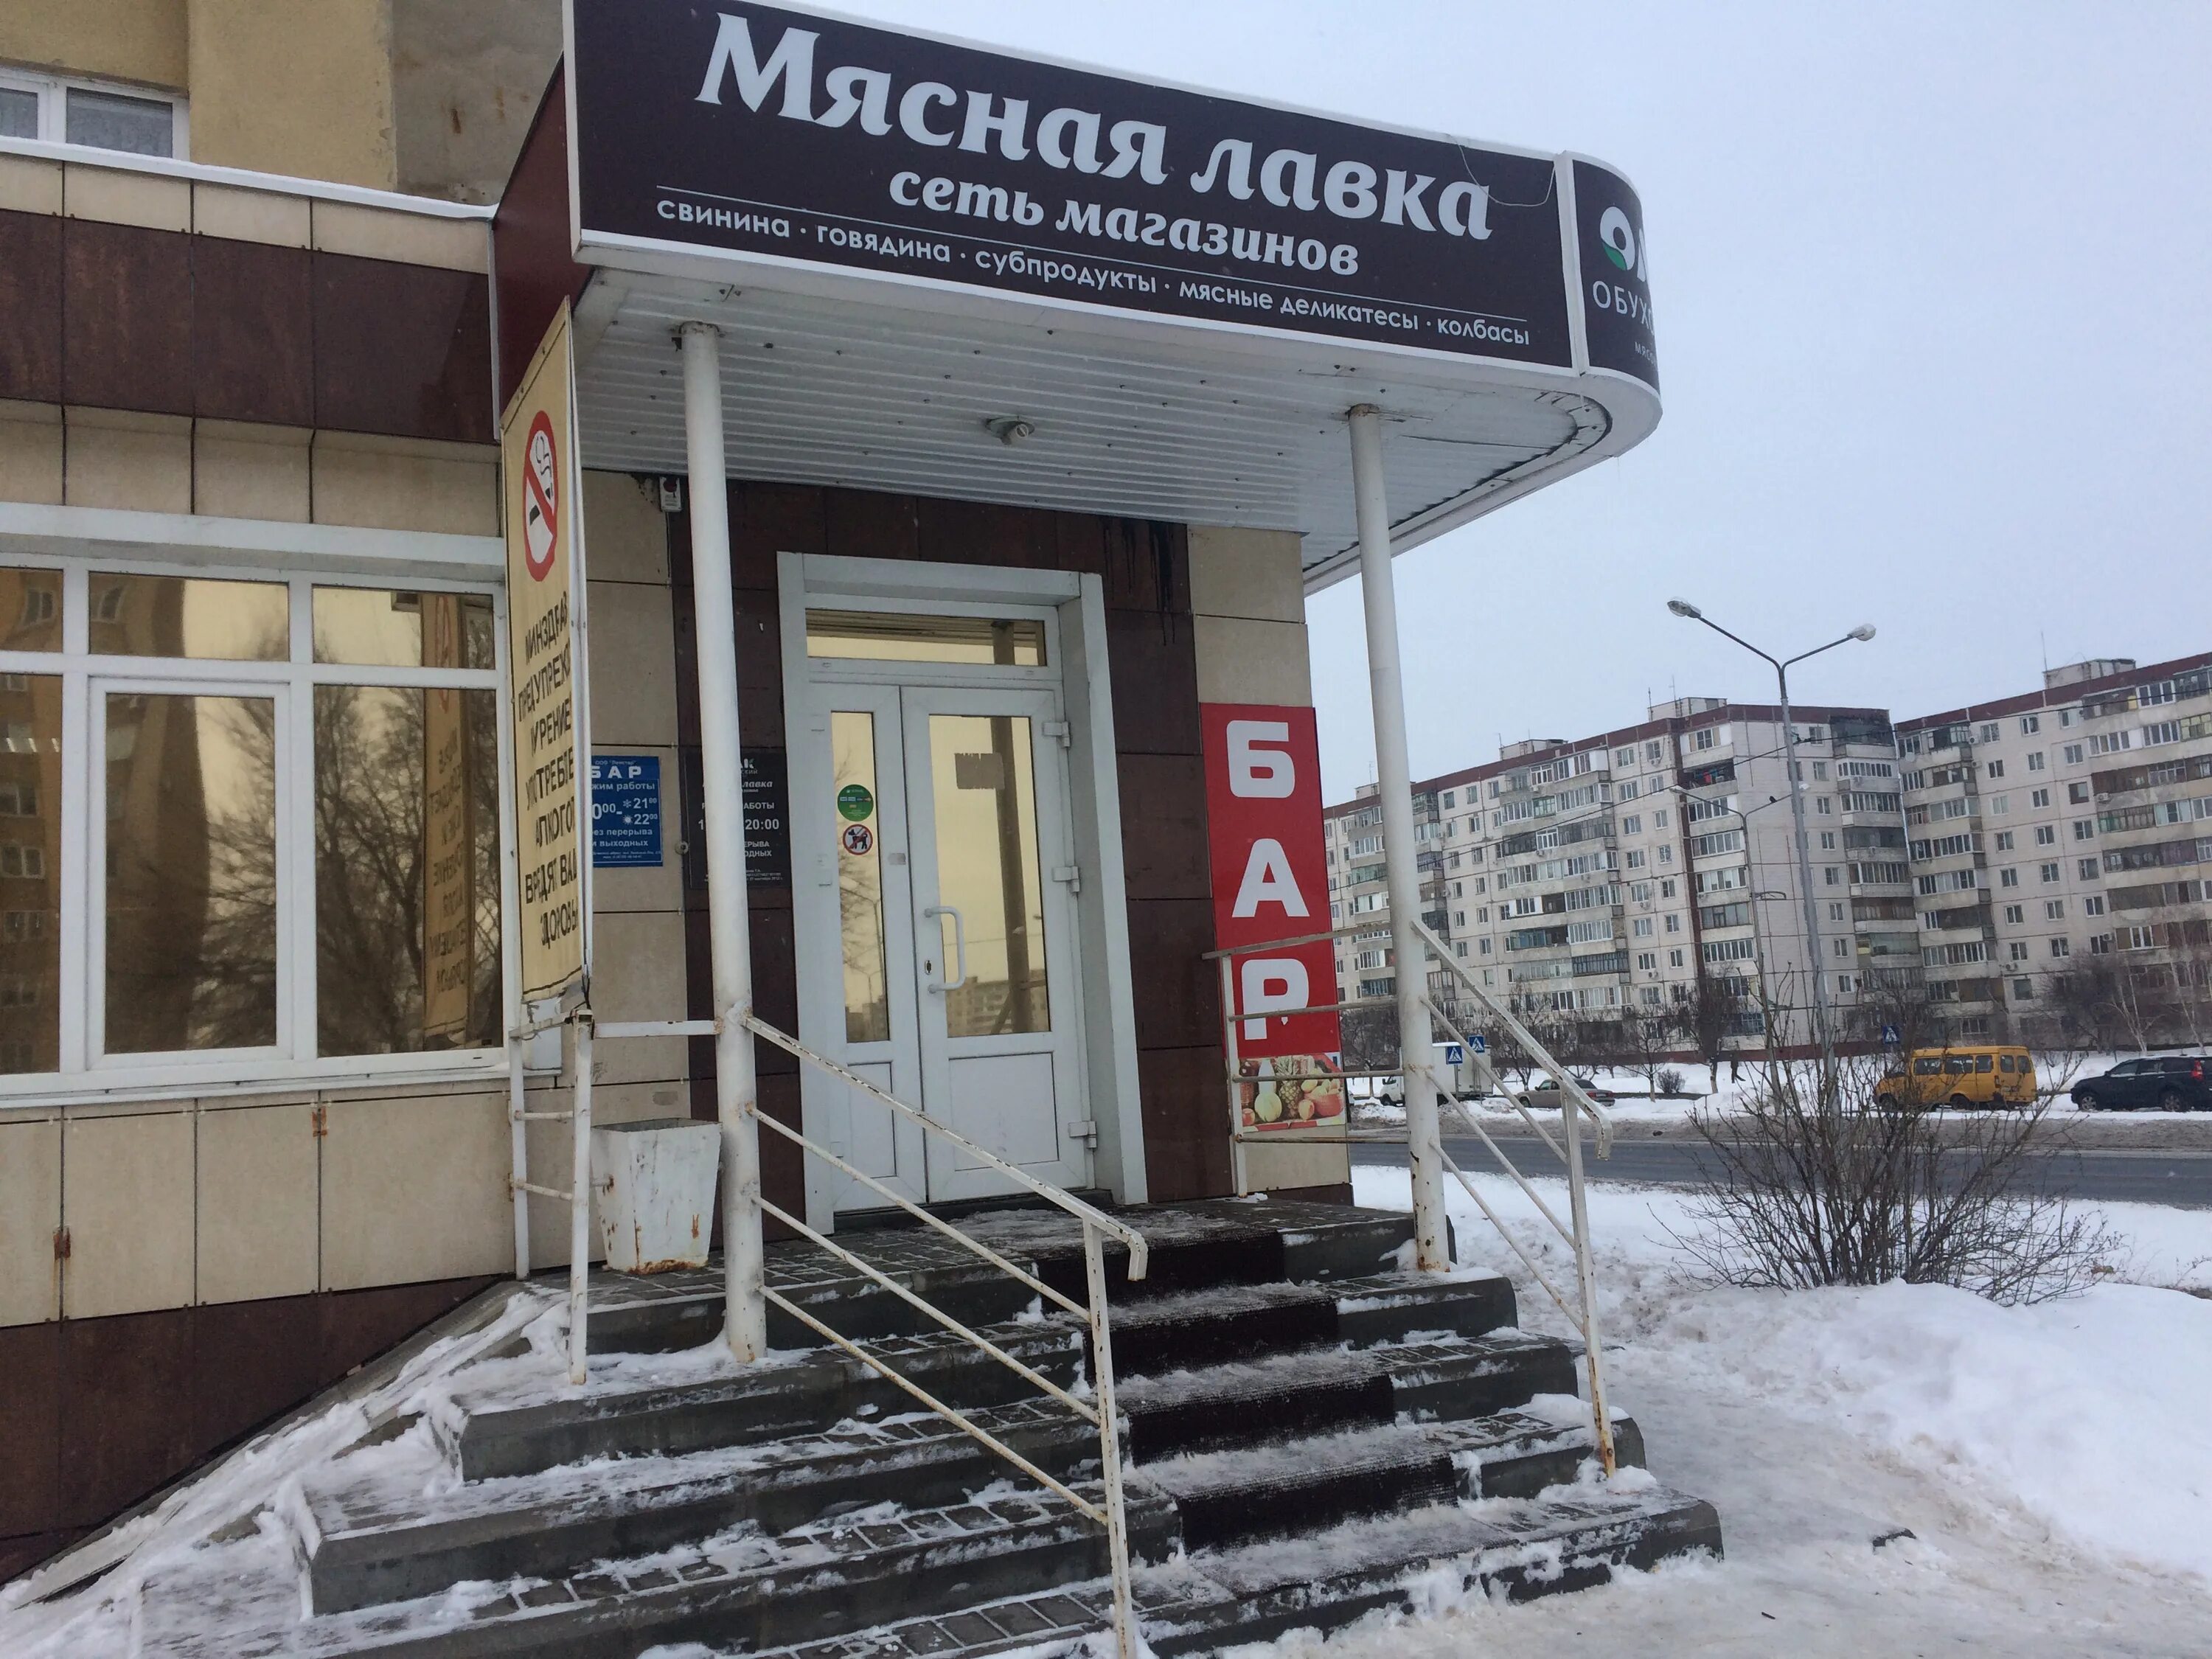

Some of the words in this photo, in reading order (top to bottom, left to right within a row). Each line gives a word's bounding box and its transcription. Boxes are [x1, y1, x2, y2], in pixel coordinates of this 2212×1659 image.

[694, 12, 1169, 185] Мясная
[1190, 139, 1493, 240] лавка
[889, 171, 1044, 226] сеть
[1055, 200, 1359, 276] магазинов
[656, 200, 790, 238] свинина
[816, 225, 950, 263] говядина
[975, 249, 1157, 293] субпродукты
[1180, 281, 1273, 310] мясные
[1280, 296, 1419, 330] деликатесы
[1437, 318, 1530, 346] колбасы
[616, 781, 655, 792] работы
[606, 829, 653, 837] перерыва
[745, 818, 779, 830] 20:00
